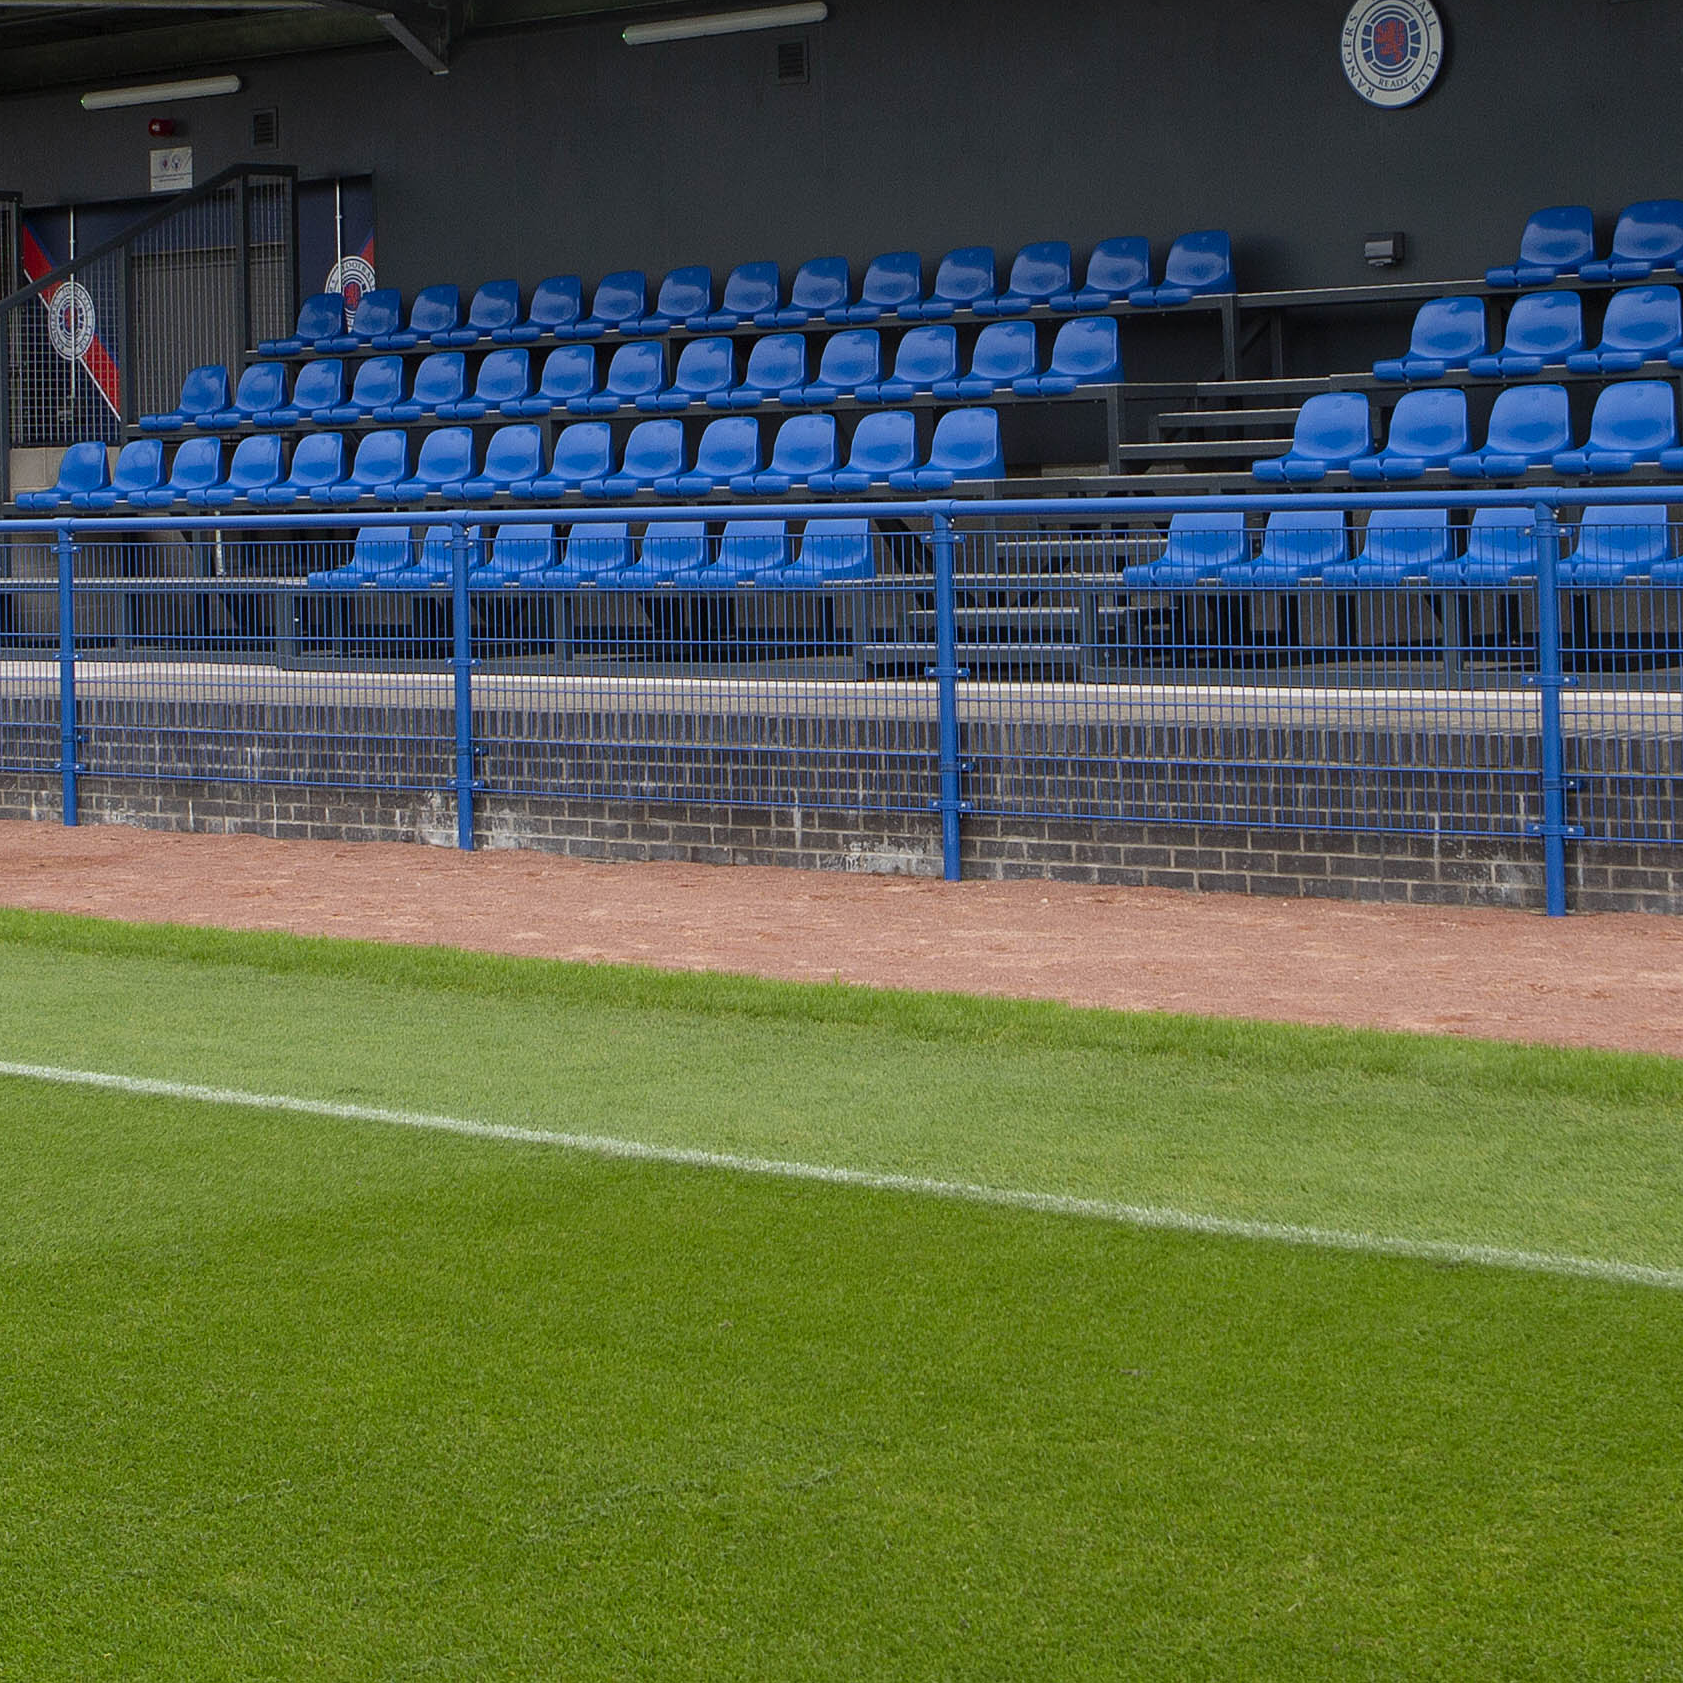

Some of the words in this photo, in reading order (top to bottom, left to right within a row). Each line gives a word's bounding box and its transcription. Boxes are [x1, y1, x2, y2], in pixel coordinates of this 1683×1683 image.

[1342, 14, 1375, 98] RANGERS
[1411, 50, 1439, 95] CLUB
[1378, 75, 1410, 88] READY
